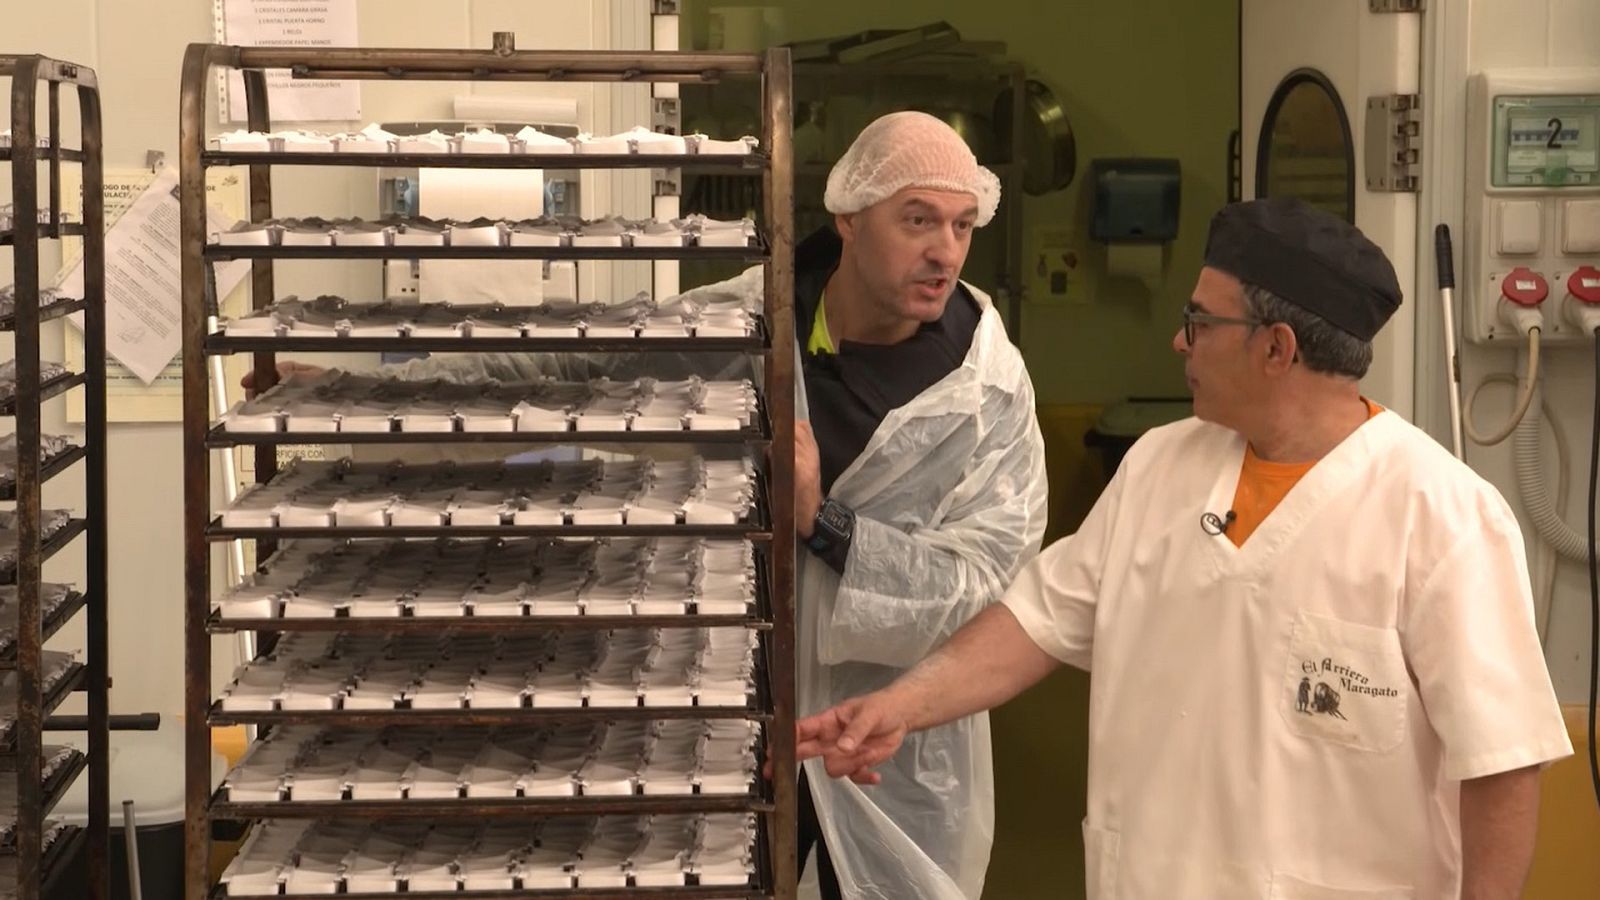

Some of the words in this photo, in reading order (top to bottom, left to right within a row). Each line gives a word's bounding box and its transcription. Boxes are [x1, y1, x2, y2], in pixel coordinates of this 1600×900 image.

[1547, 118, 1562, 149] 2
[307, 449, 325, 458] CON
[1302, 659, 1317, 674] El
[1339, 677, 1398, 698] Maragato
